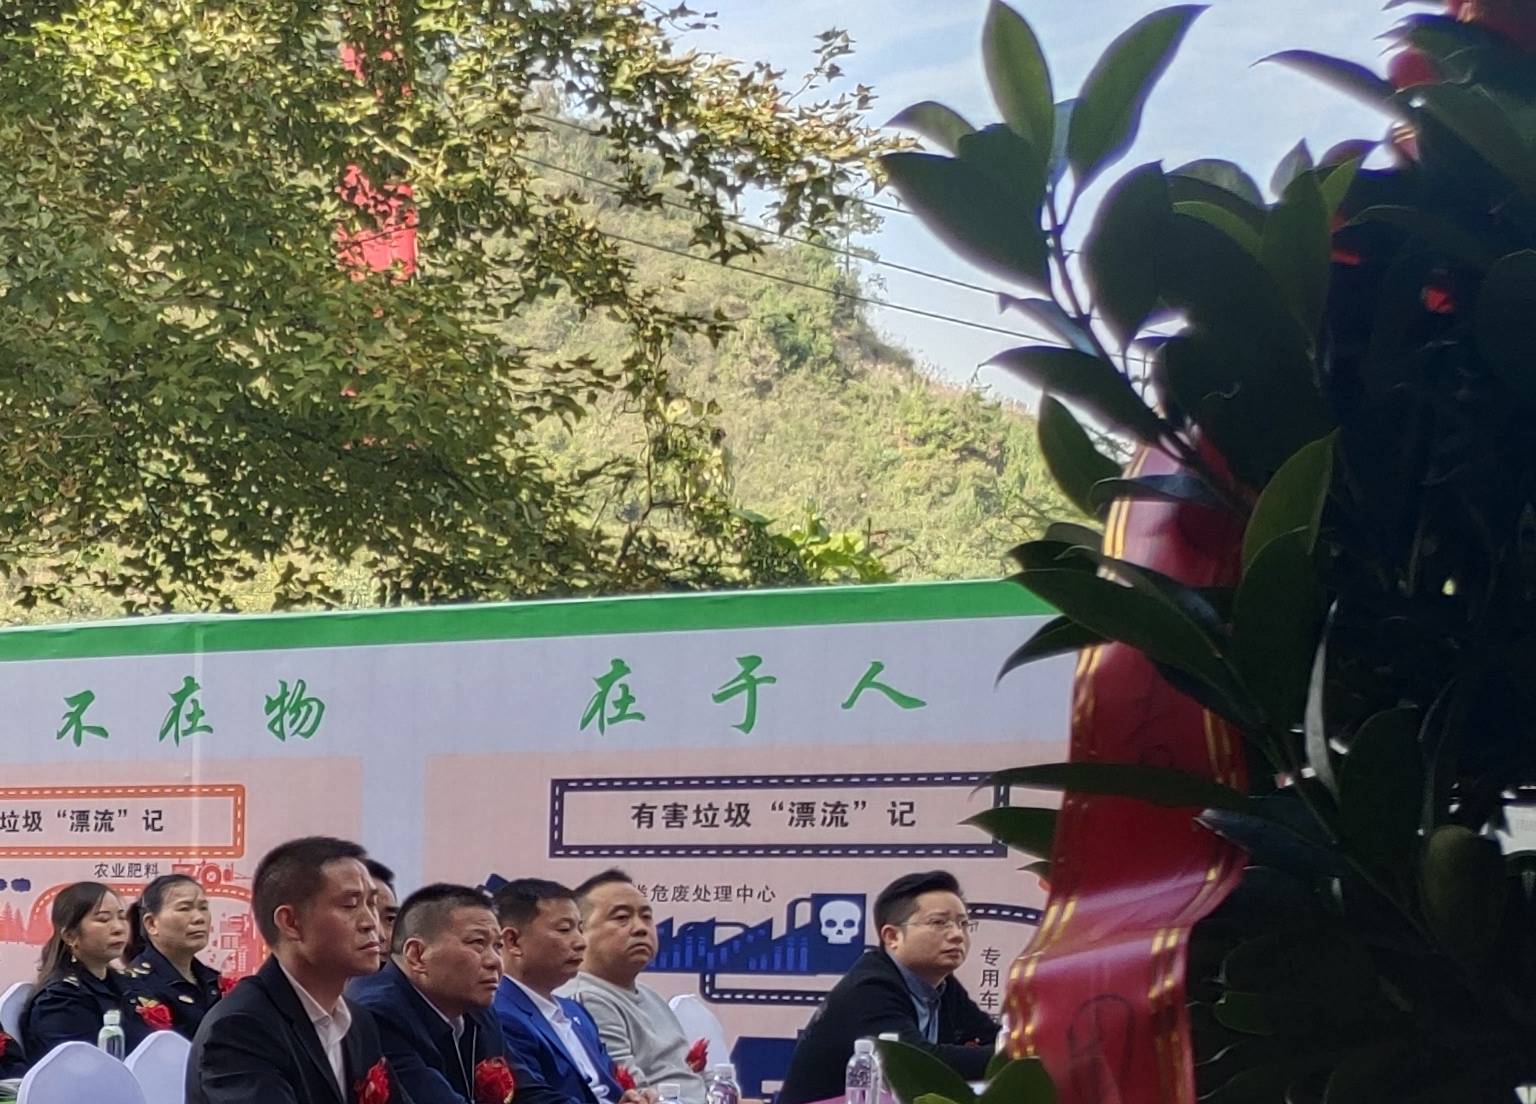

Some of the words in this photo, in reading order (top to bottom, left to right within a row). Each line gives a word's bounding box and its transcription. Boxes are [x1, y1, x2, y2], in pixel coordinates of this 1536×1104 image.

[56, 674, 327, 748] 不在物
[579, 653, 928, 733] 在于人
[630, 799, 917, 830] 有害垃圾“漂流”记
[93, 862, 160, 879] 农业肥料
[979, 946, 1001, 1023] 专用车
